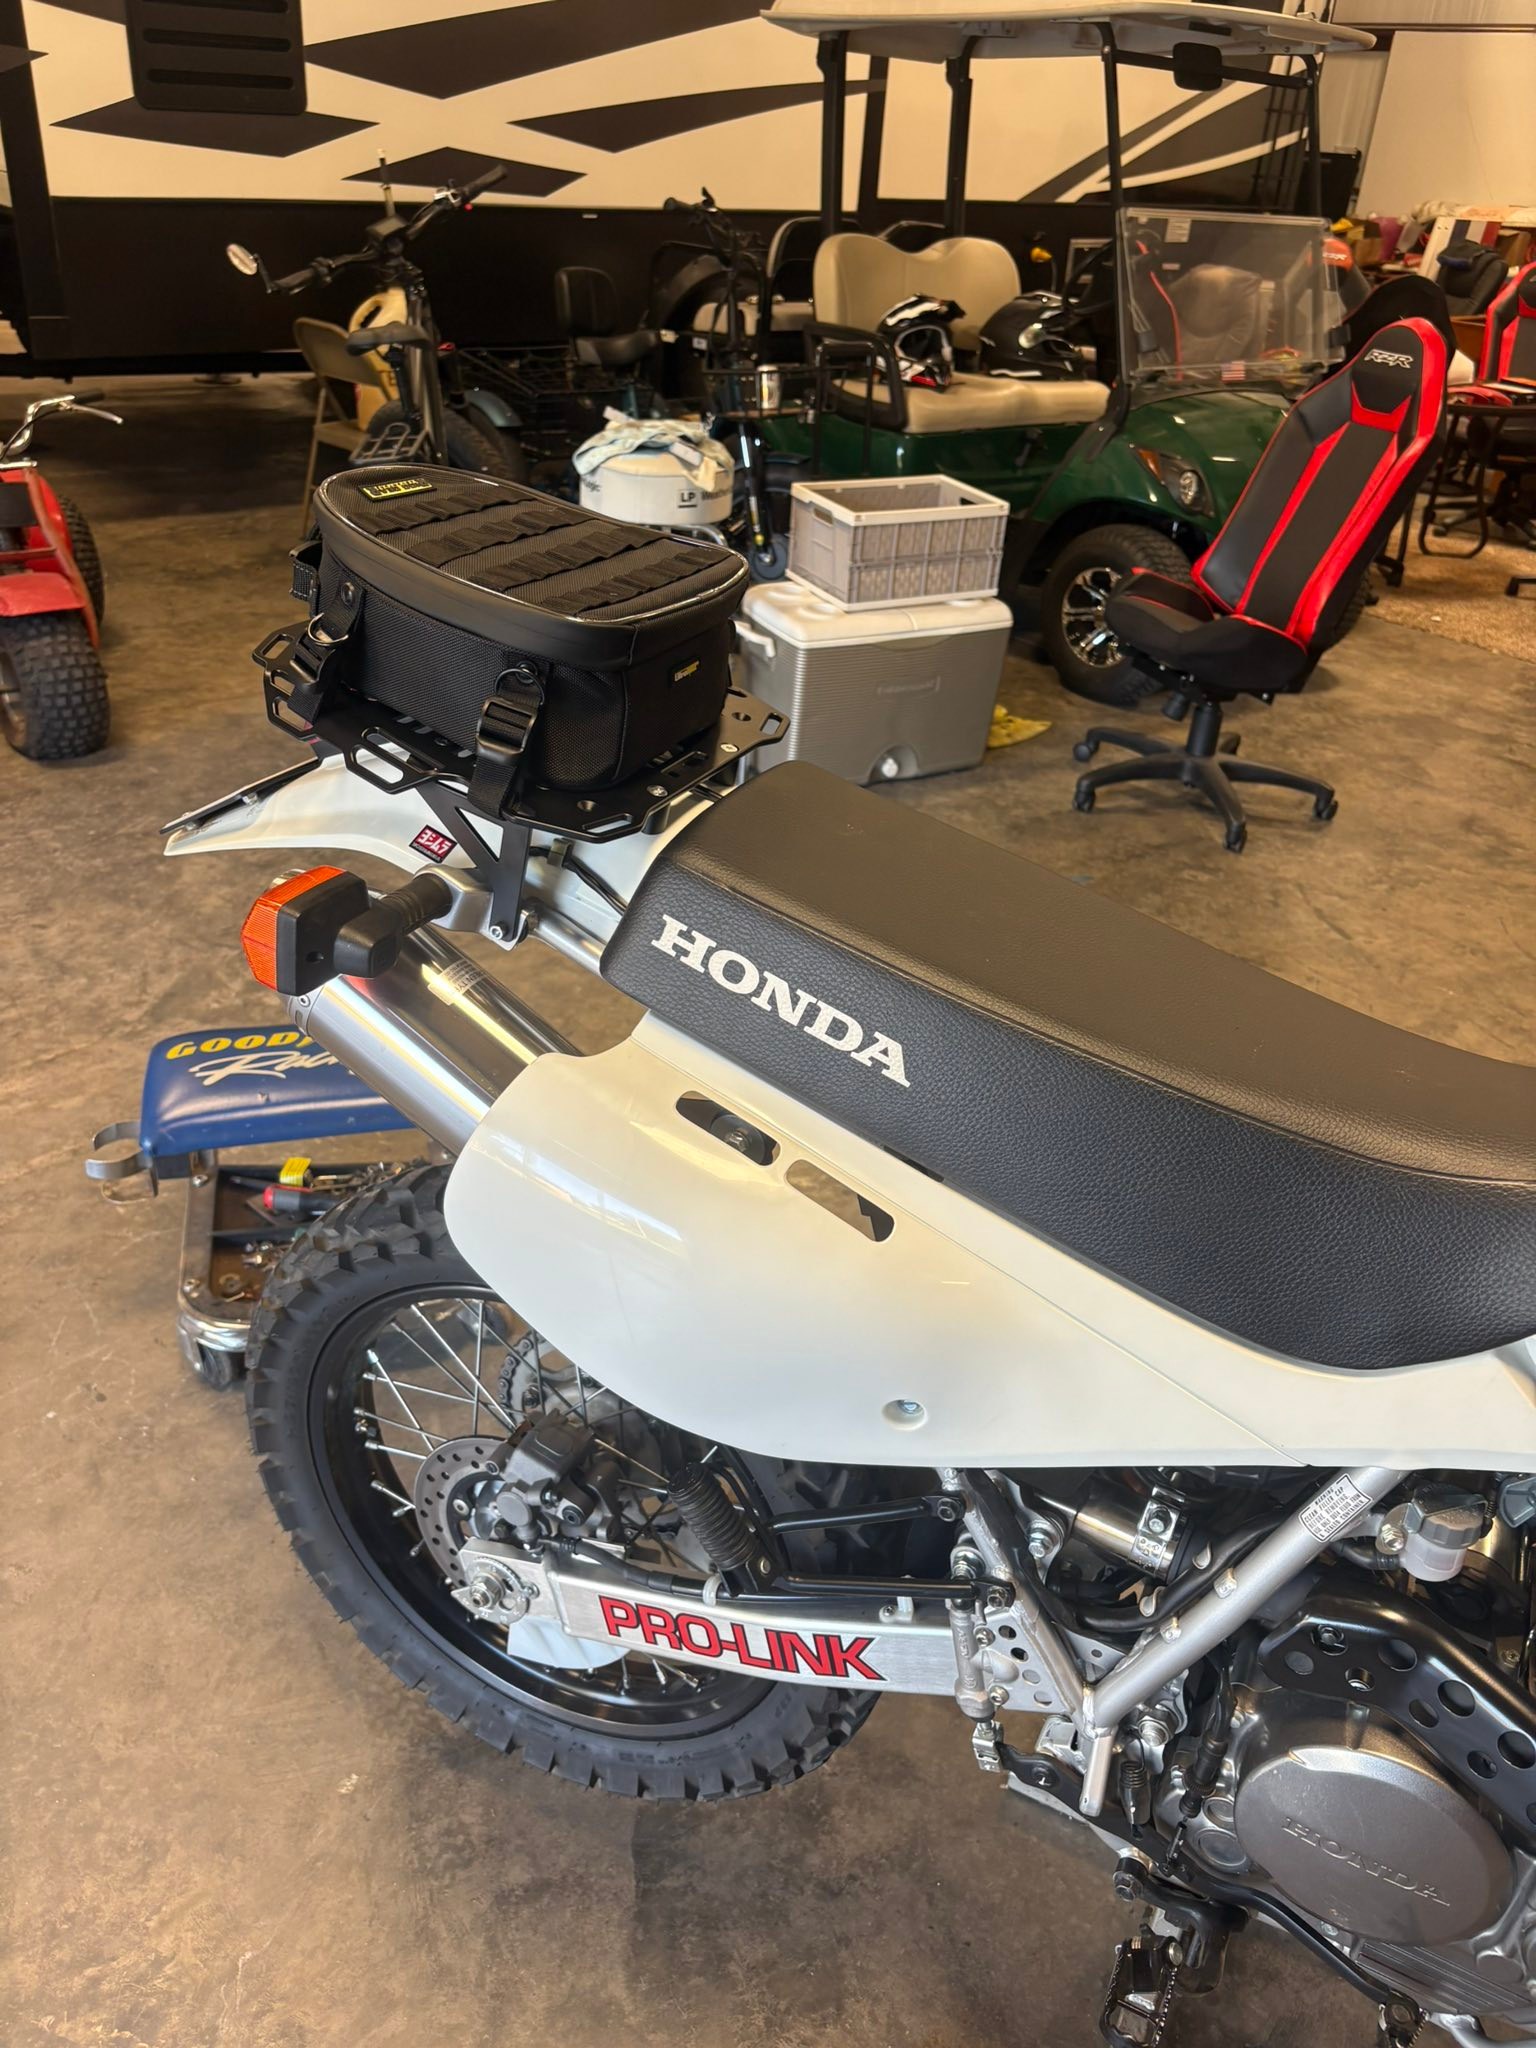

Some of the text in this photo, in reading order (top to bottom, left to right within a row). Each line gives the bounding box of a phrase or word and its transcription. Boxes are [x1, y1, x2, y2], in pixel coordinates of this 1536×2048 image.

[1364, 348, 1414, 369] RZR
[680, 491, 697, 503] LP
[651, 914, 911, 1088] HONDA
[1304, 1486, 1344, 1523] CLEAN FILLER CAP
[1315, 1487, 1334, 1505] WARNING
[598, 1594, 888, 1681] PRO-LINK
[1281, 1816, 1451, 1908] HONDA
